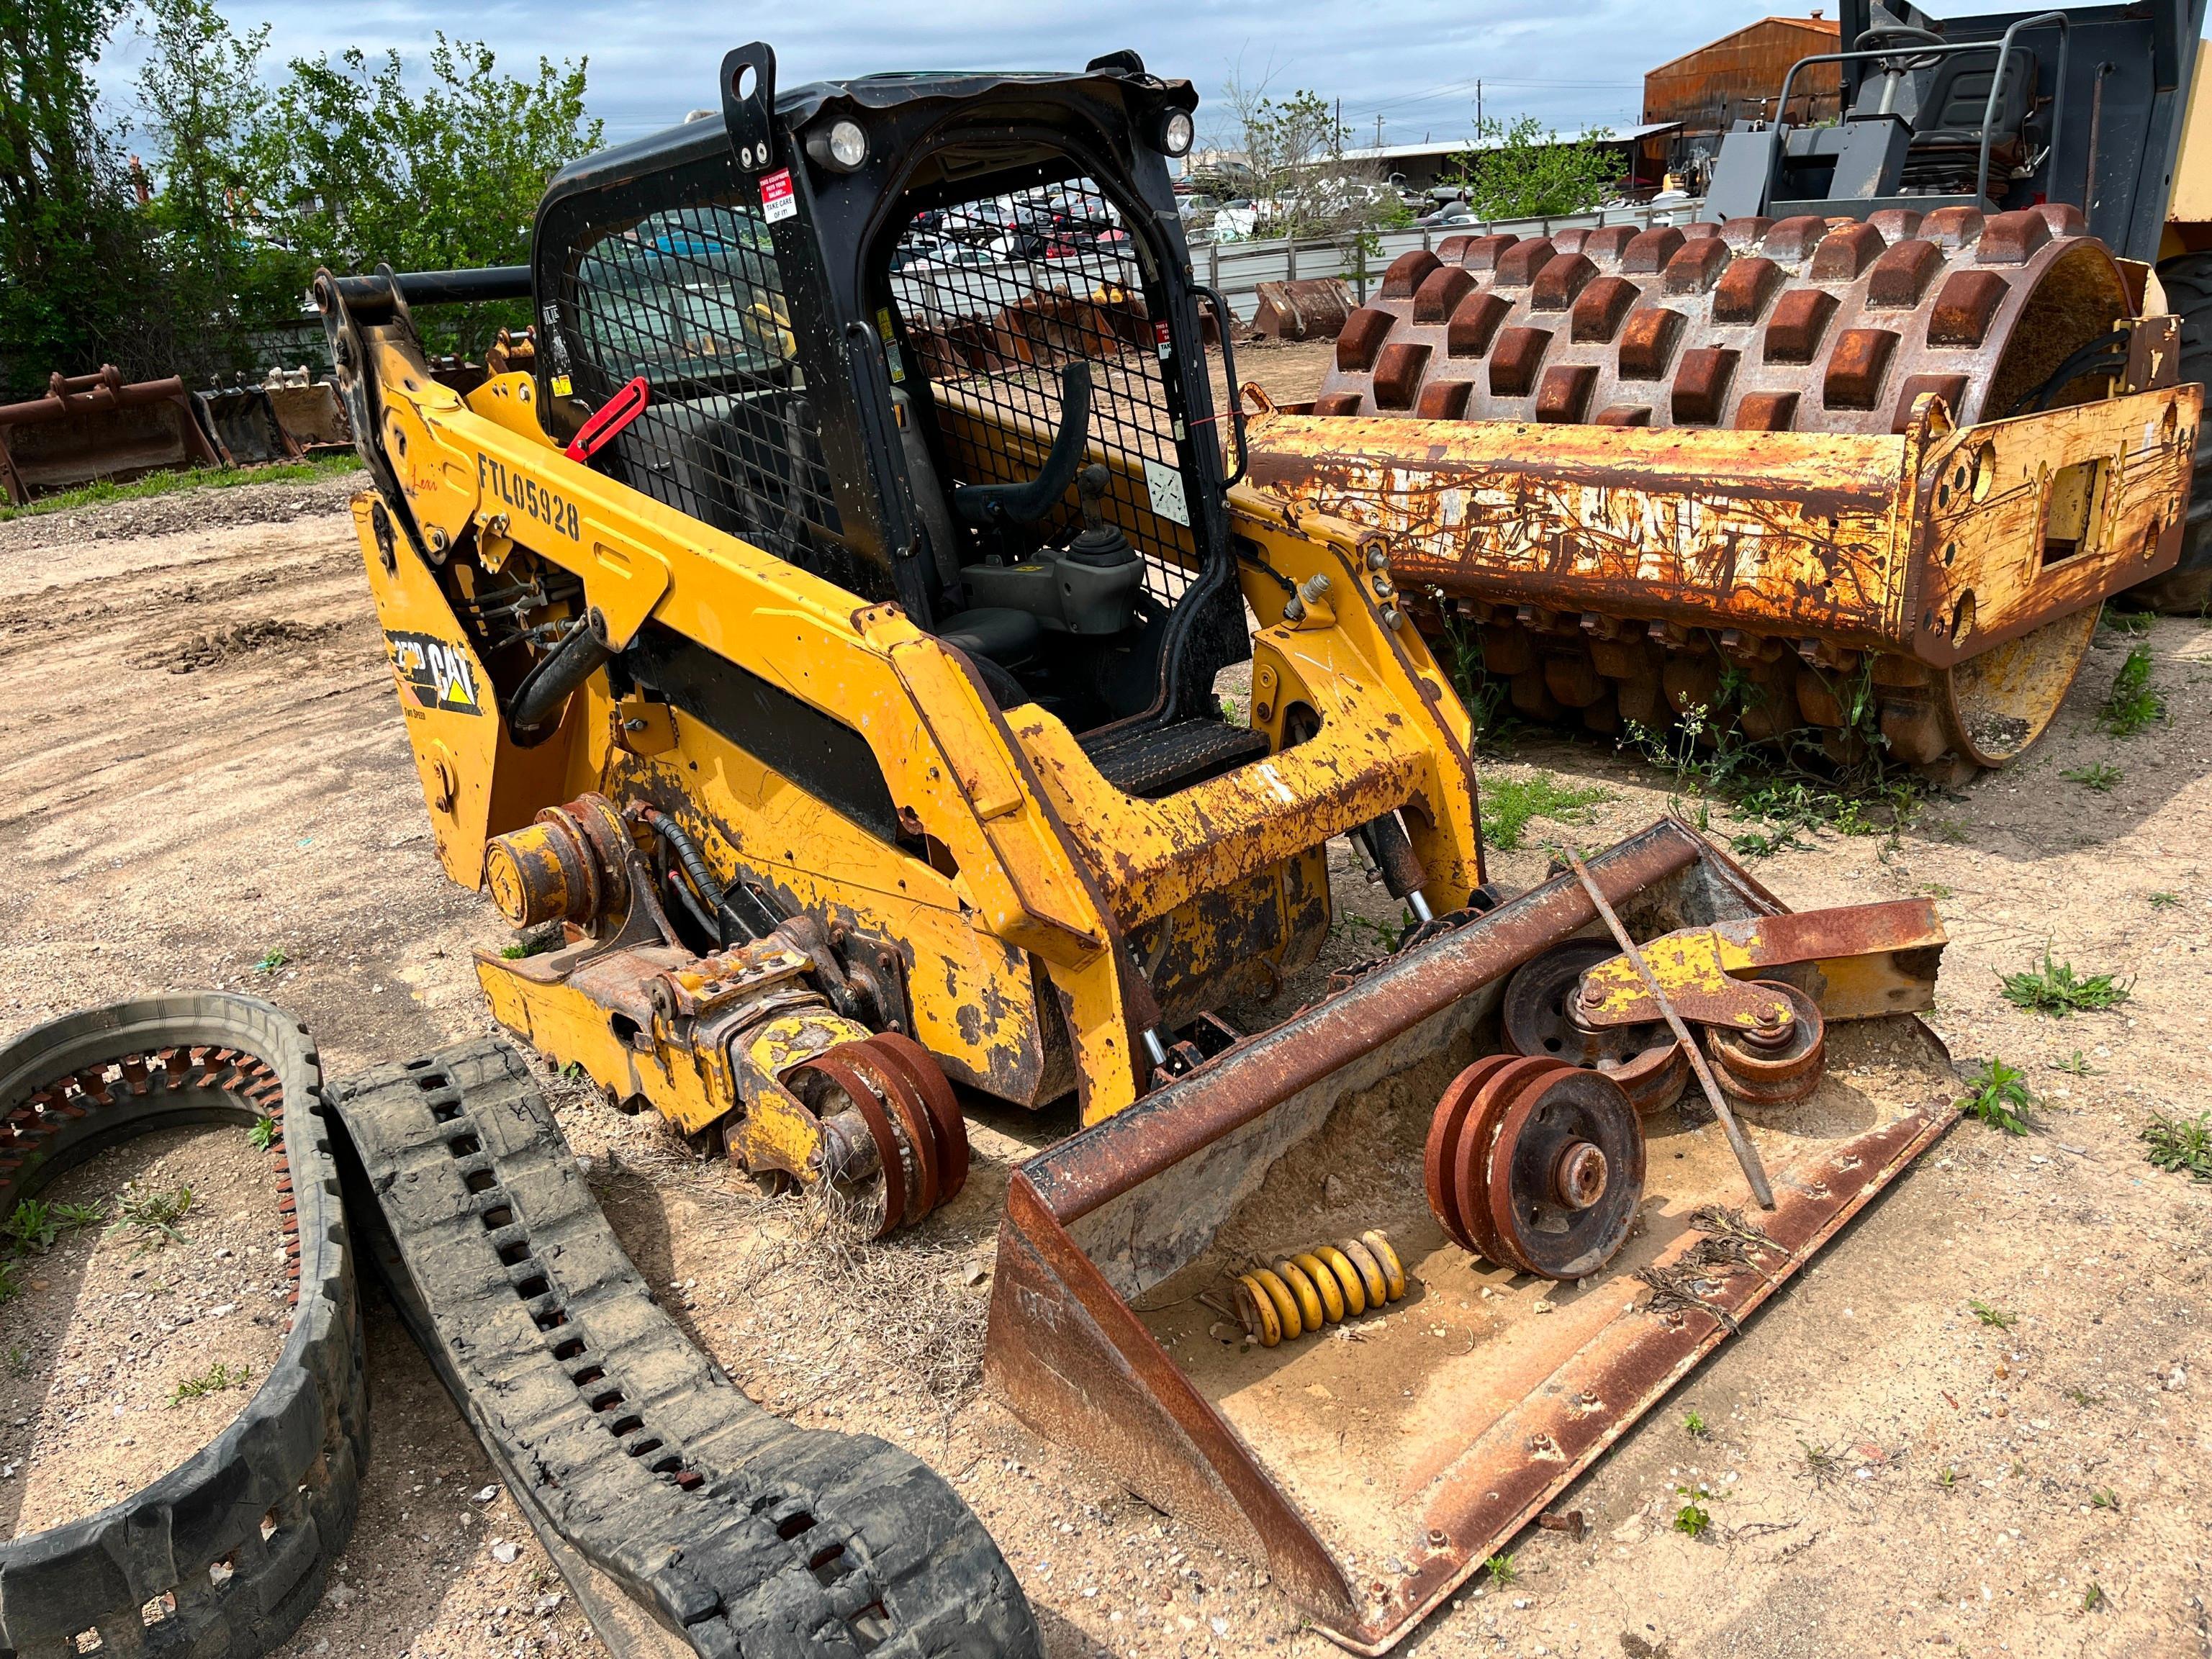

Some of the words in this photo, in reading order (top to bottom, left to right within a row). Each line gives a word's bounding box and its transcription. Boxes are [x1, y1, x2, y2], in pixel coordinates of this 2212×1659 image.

[767, 202, 779, 212] TAKE
[780, 196, 793, 207] CARE
[477, 451, 579, 542] FTL05928
[428, 643, 477, 705] CAT
